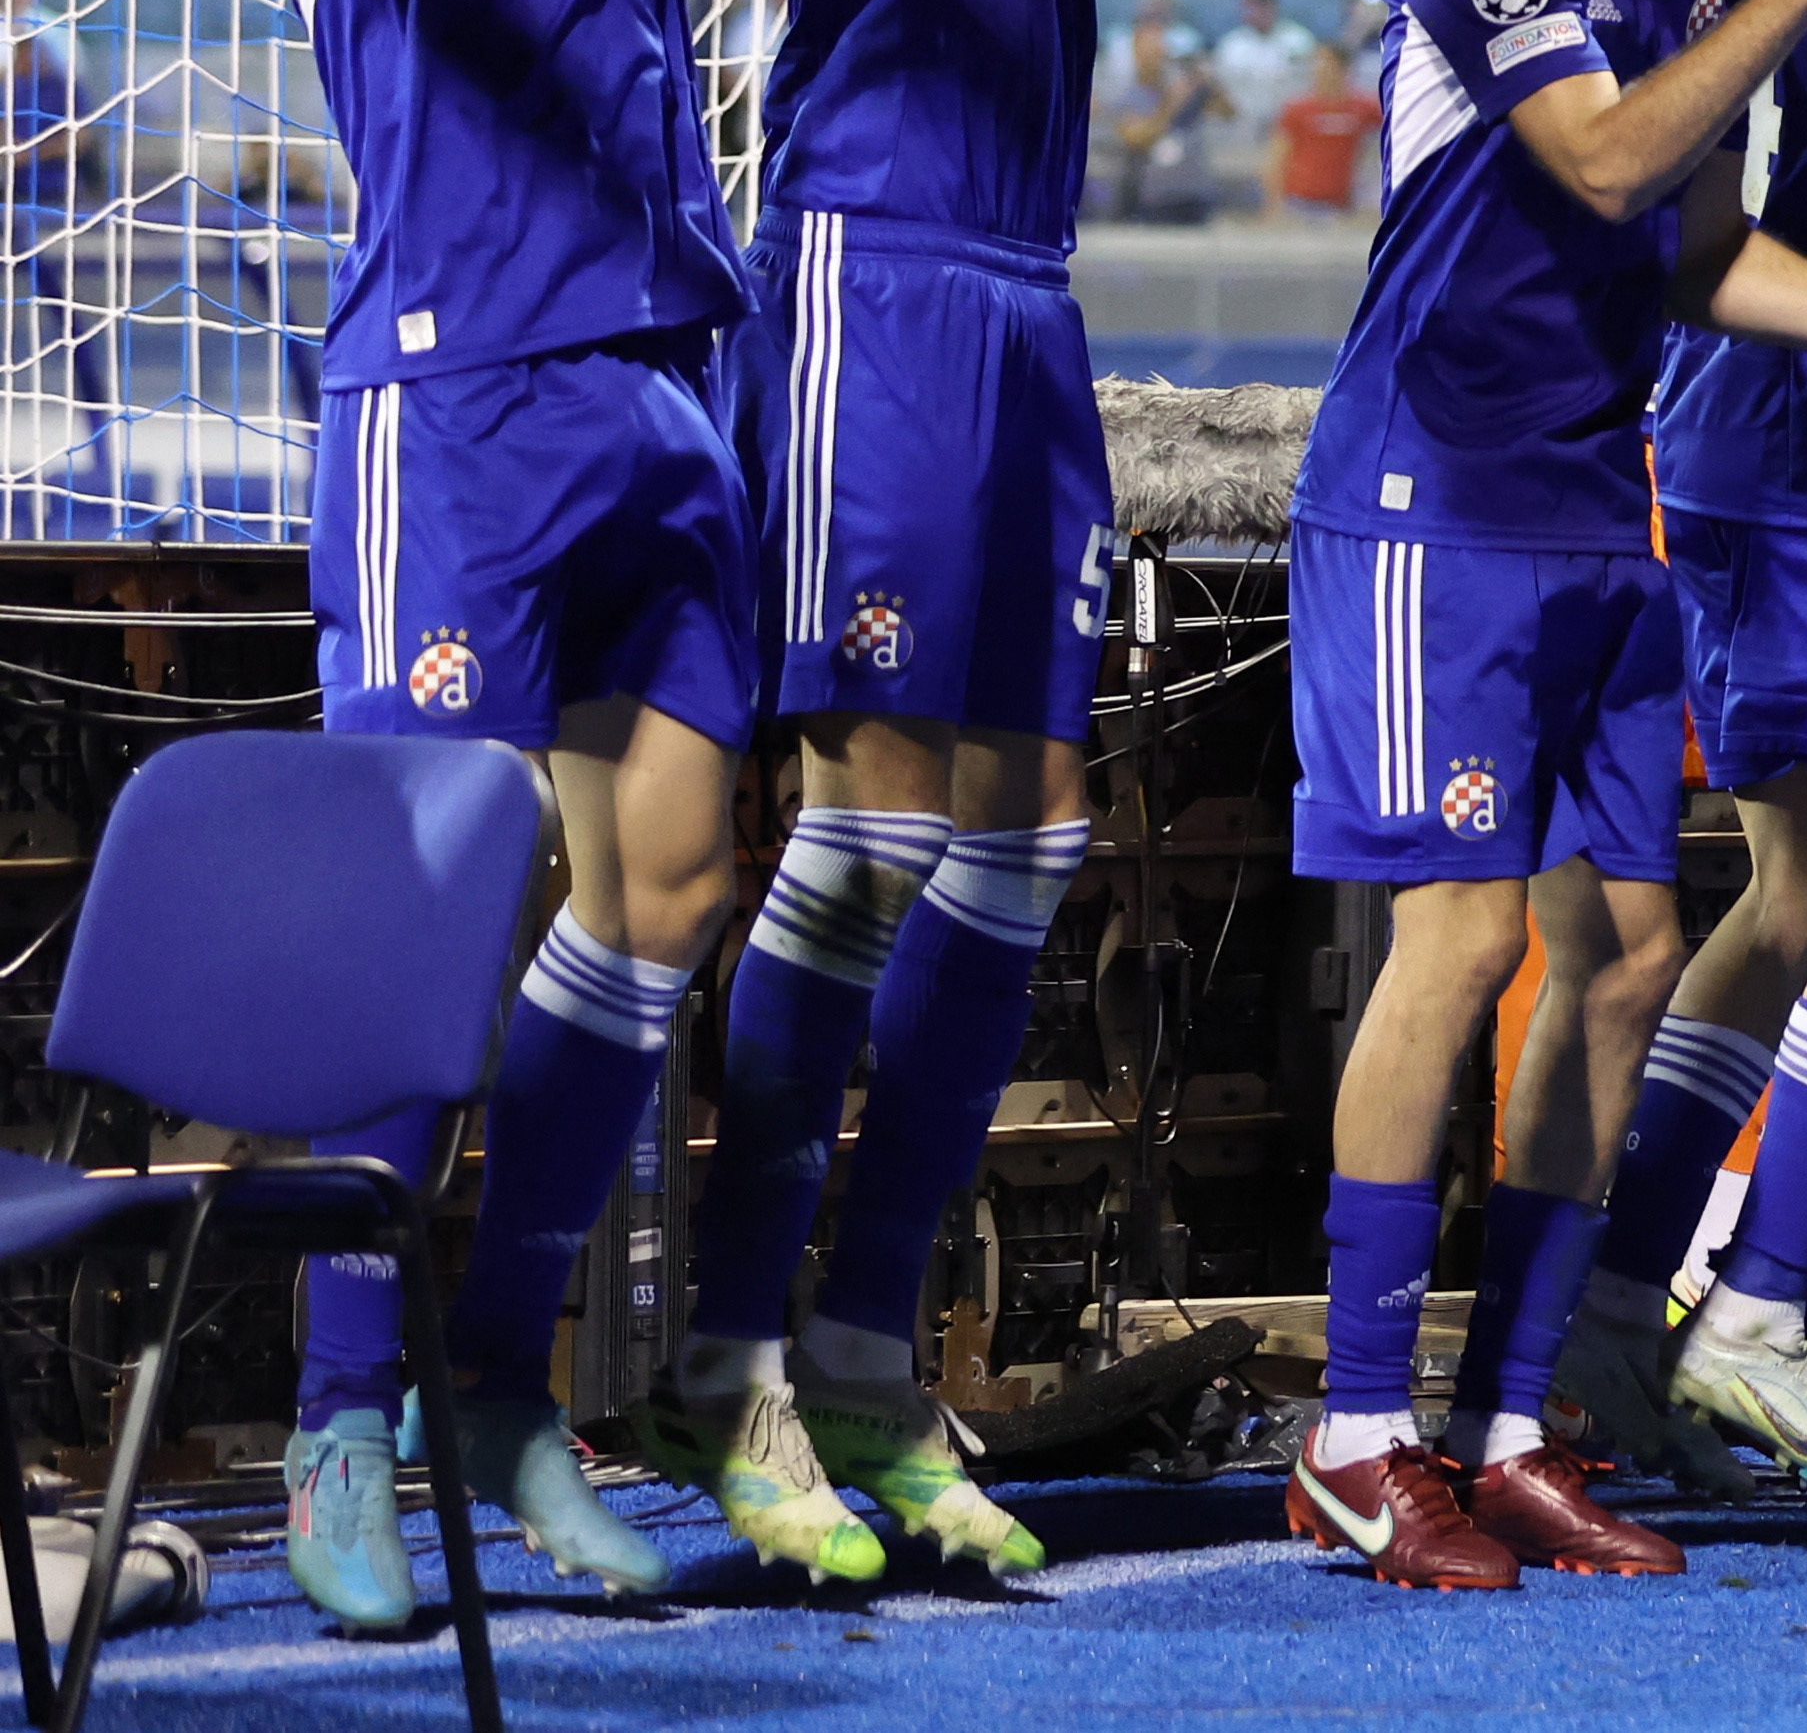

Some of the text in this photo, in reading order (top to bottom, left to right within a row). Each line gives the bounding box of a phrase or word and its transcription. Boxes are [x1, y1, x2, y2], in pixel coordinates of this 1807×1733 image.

[1072, 523, 1114, 640] 5
[1137, 558, 1148, 641] CROATEL
[632, 1284, 656, 1306] 133
